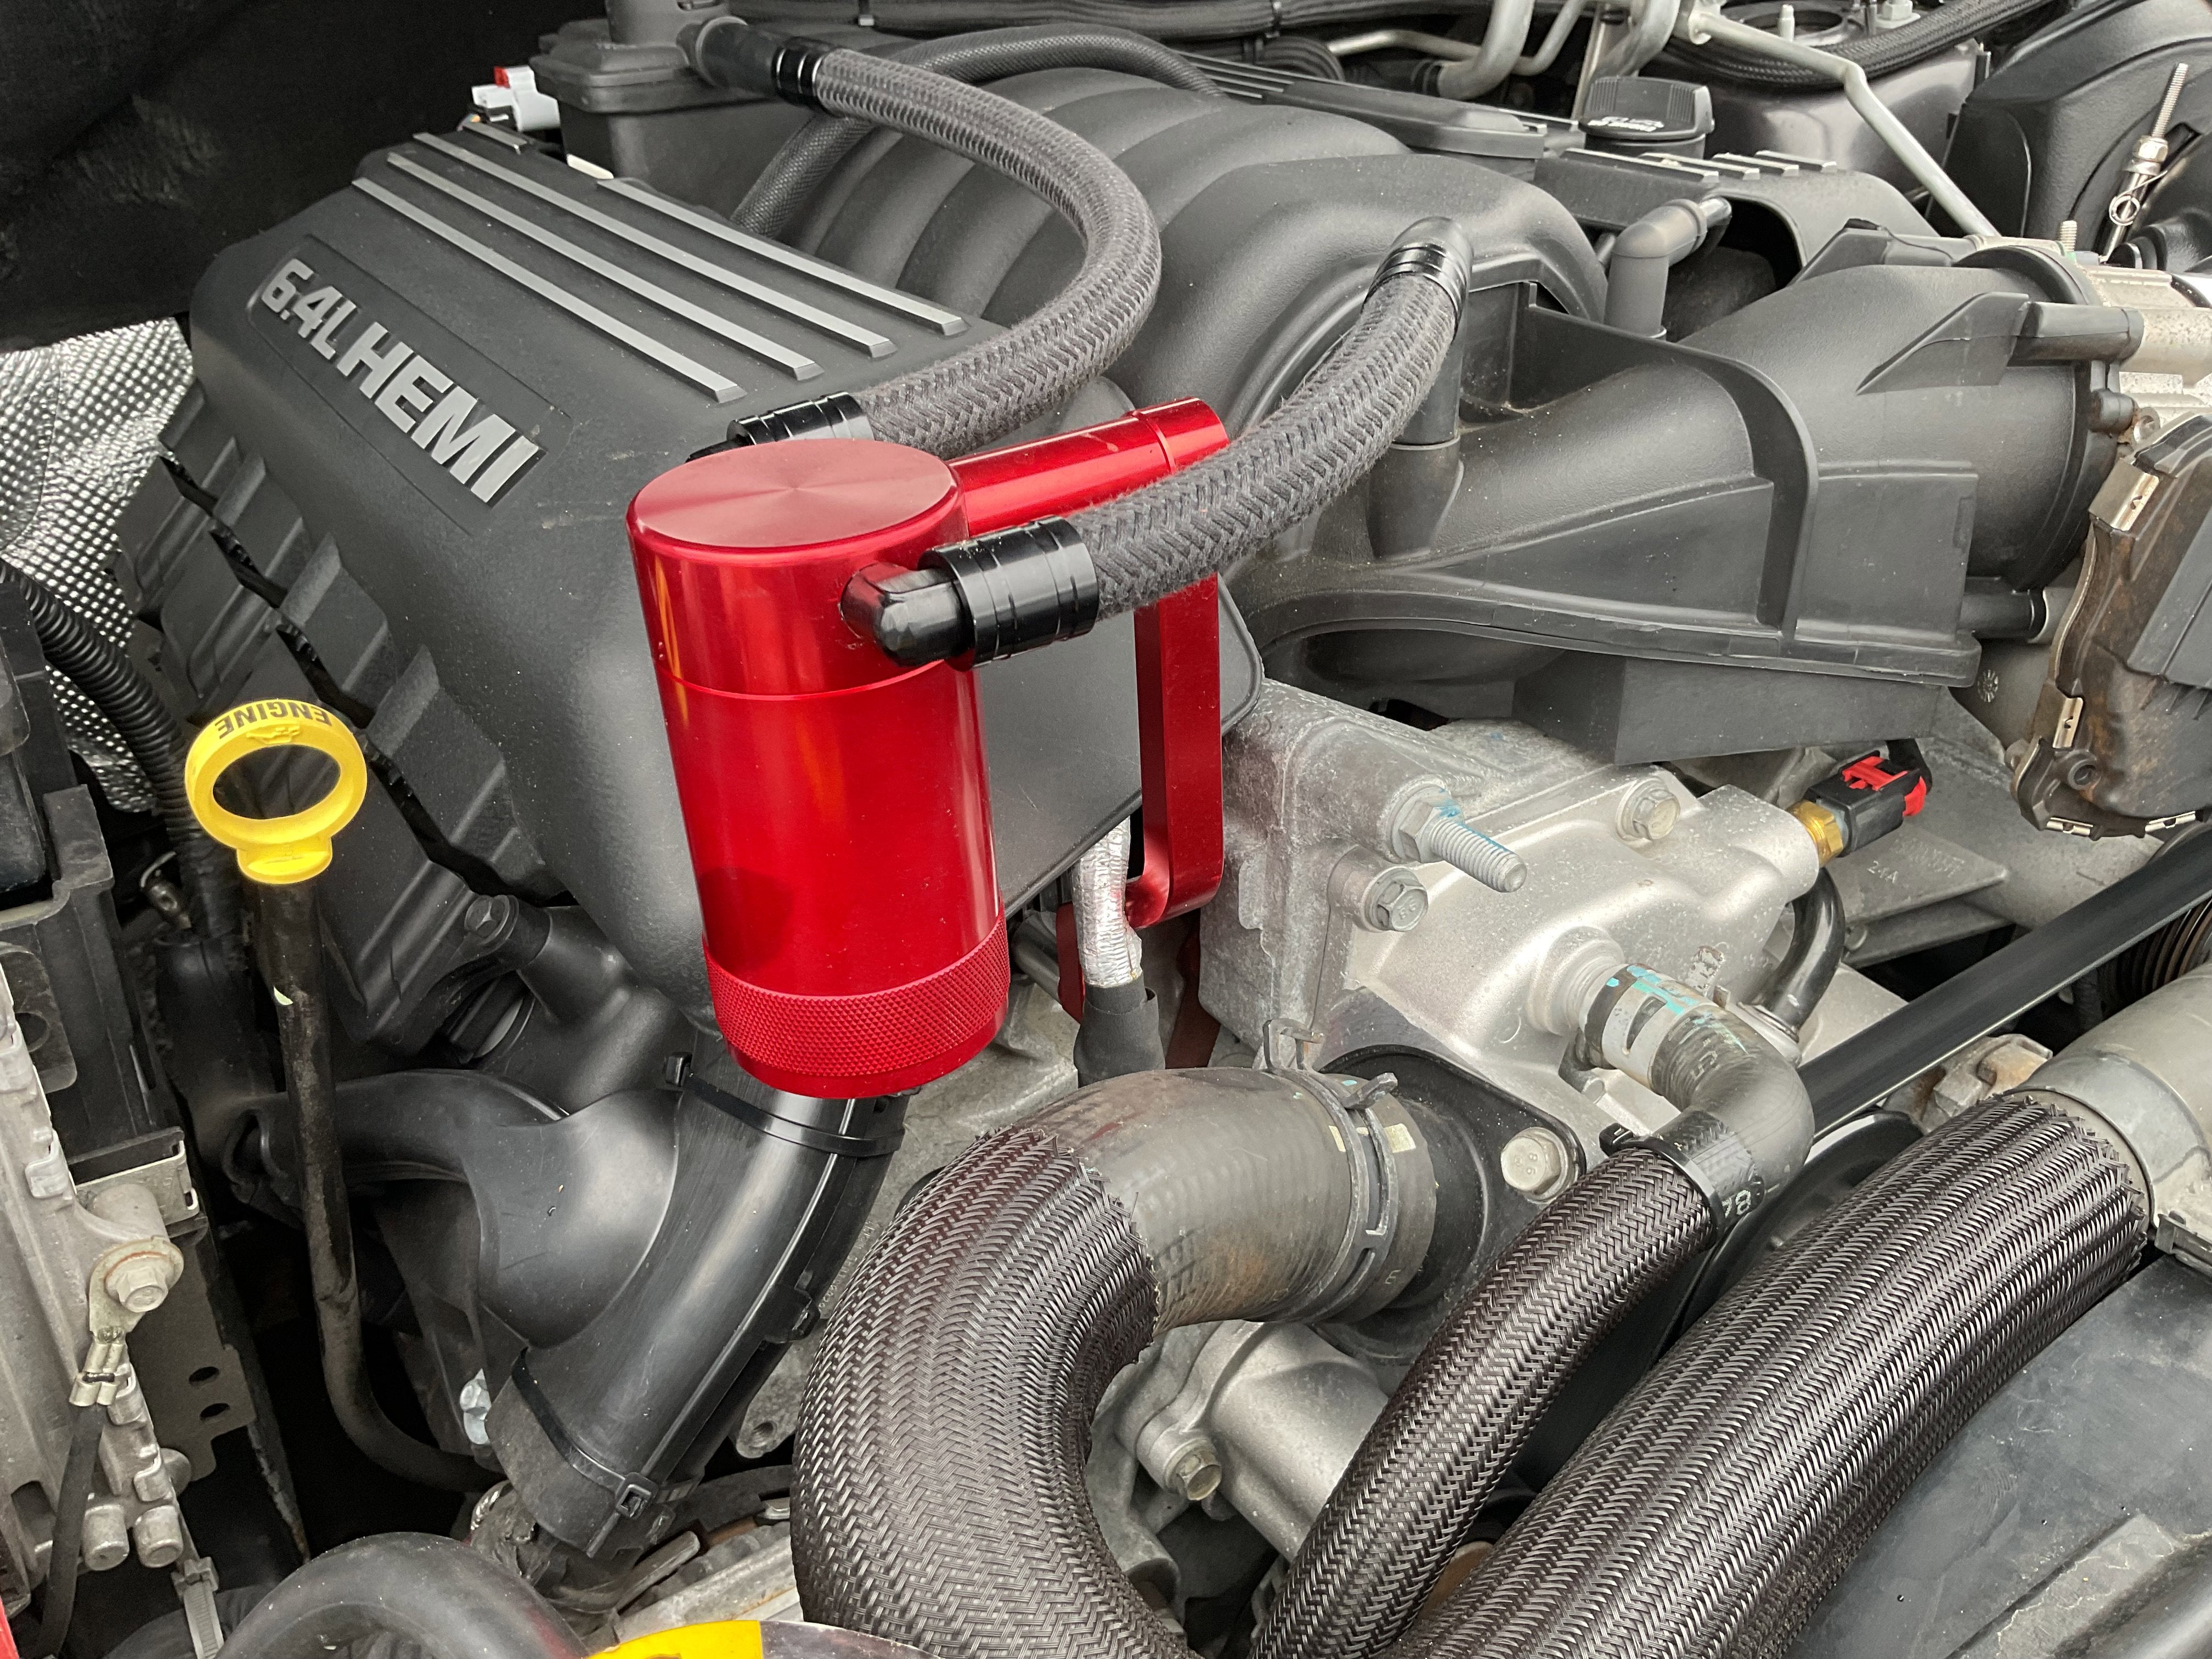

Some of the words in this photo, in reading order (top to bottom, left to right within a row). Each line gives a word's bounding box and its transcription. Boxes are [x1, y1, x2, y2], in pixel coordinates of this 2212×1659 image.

[261, 258, 357, 360] 6.4L
[336, 321, 539, 503] HEMI
[215, 701, 332, 739] ENGINE
